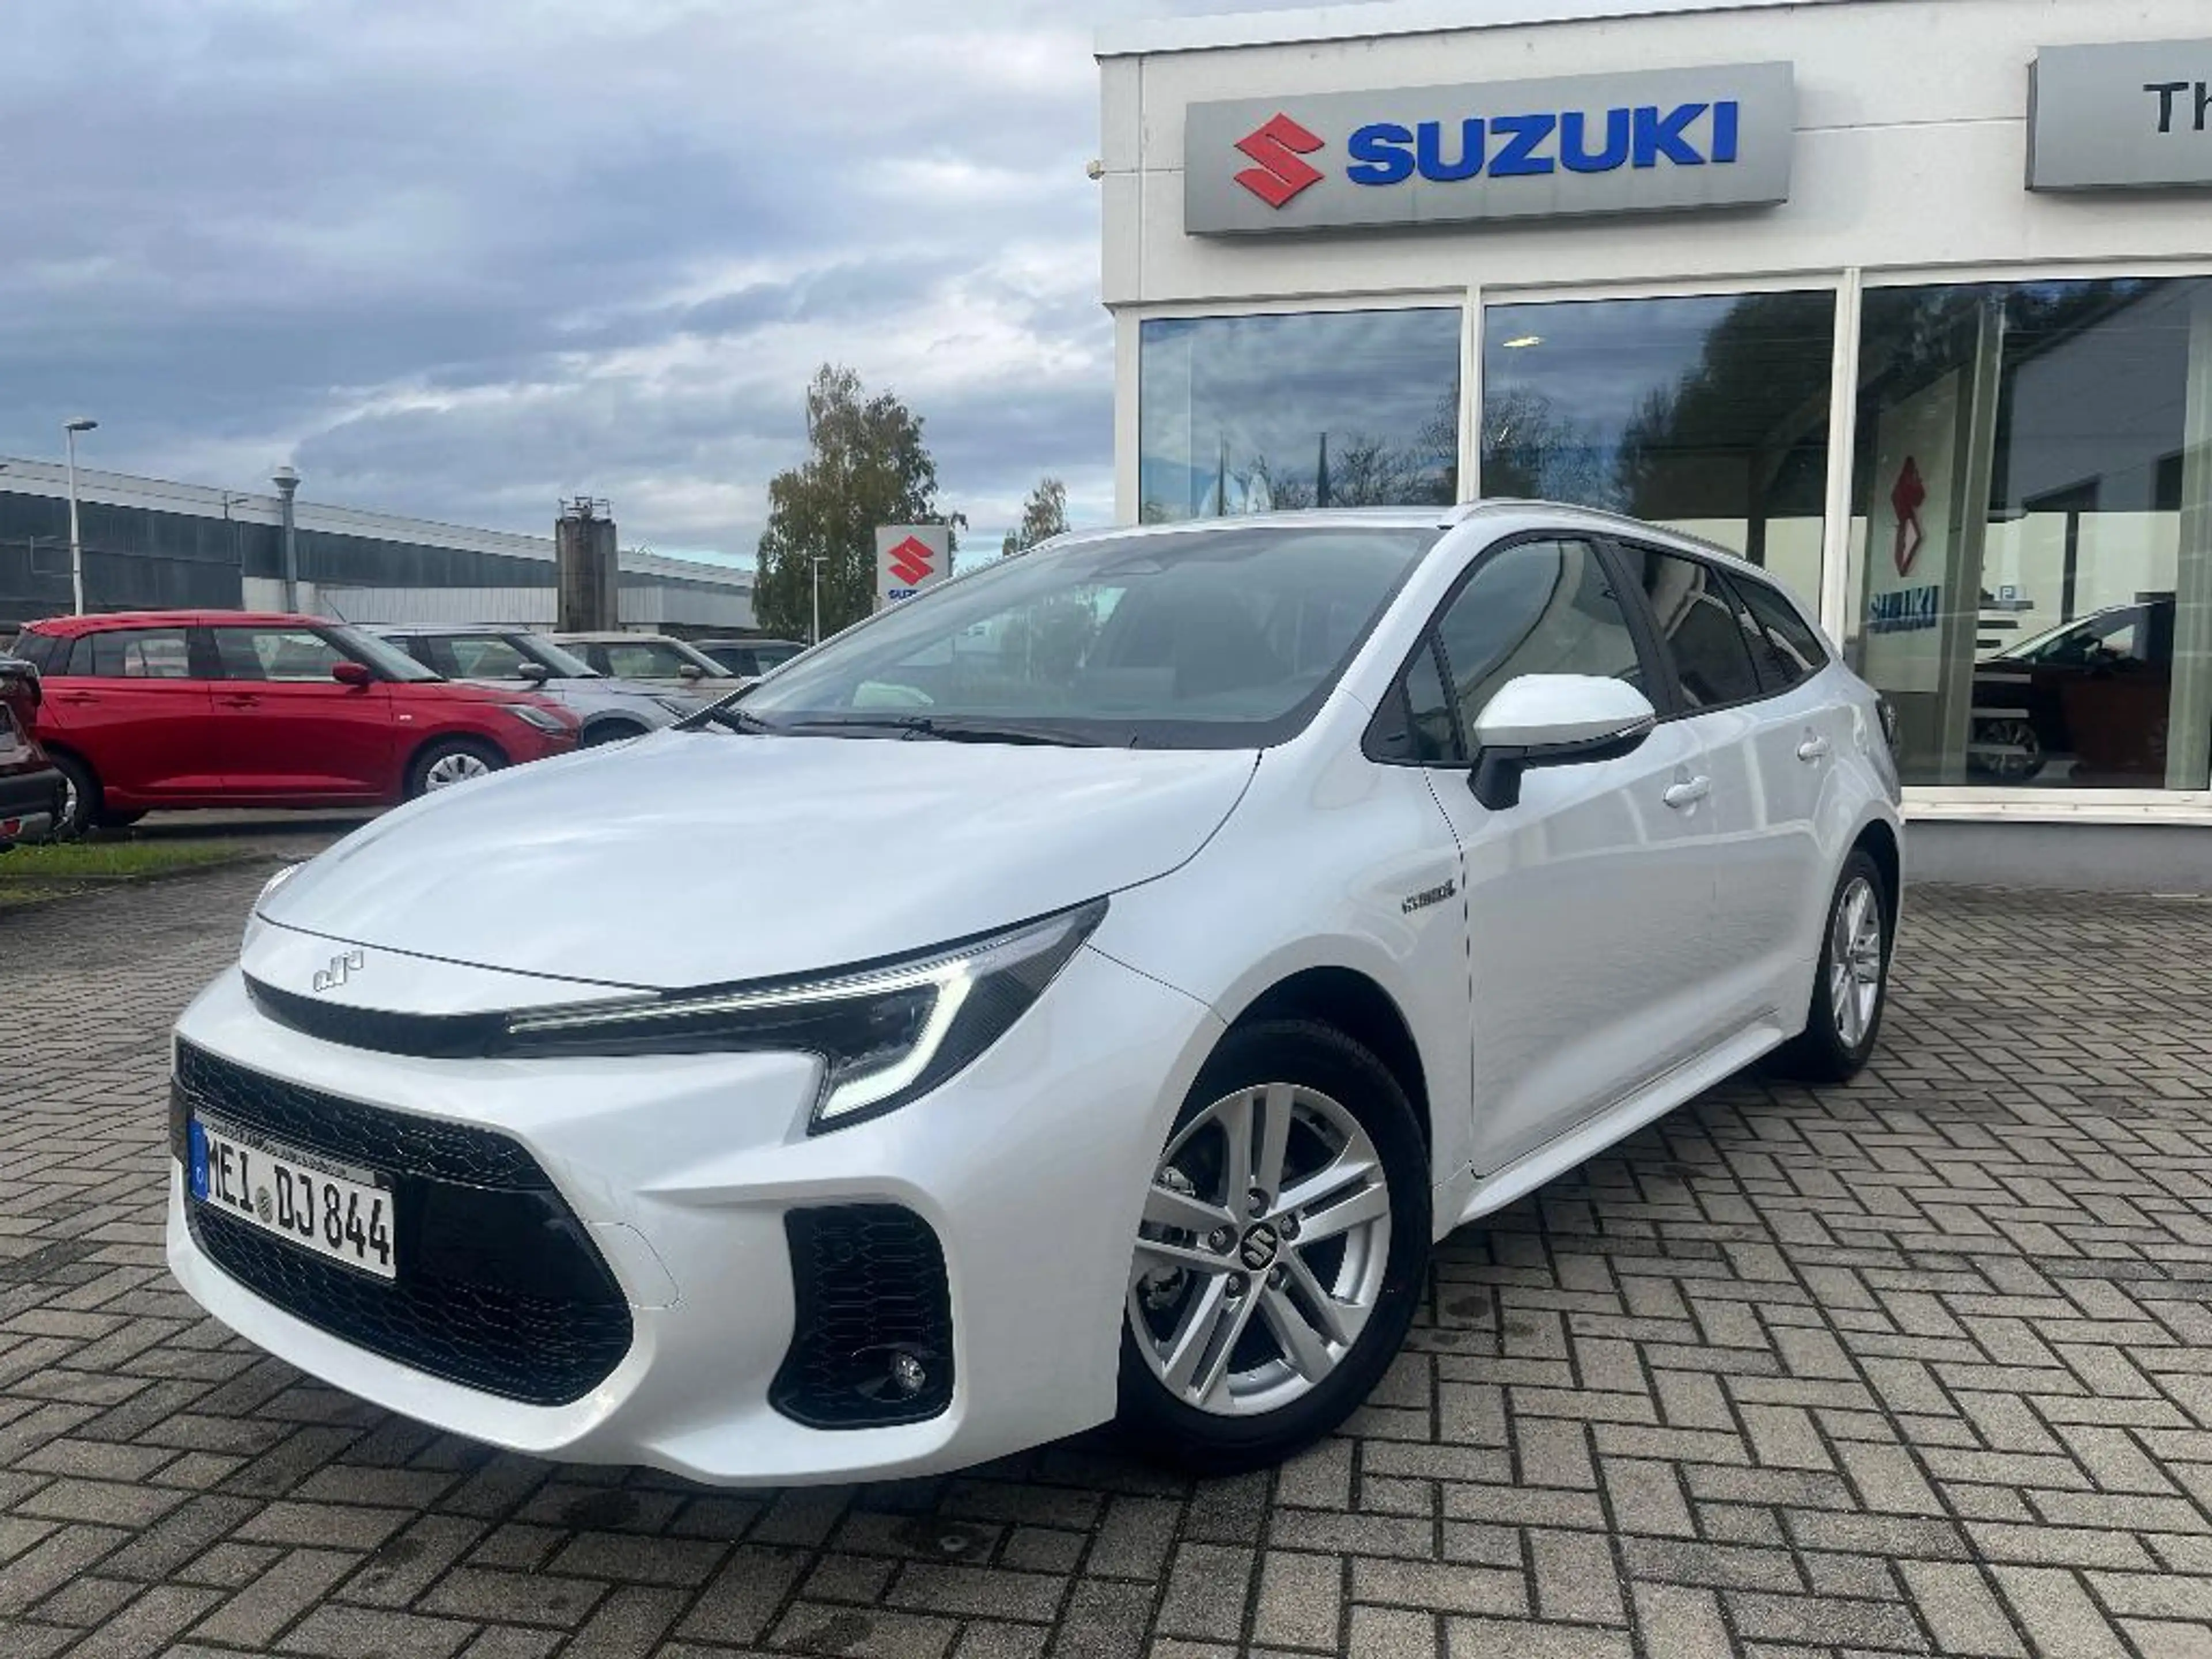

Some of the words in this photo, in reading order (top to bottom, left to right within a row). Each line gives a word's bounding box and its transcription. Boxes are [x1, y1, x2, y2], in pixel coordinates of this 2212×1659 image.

[1346, 101, 1738, 185] SUZUKI
[274, 1164, 315, 1236] DJ
[324, 1181, 390, 1264] 844
